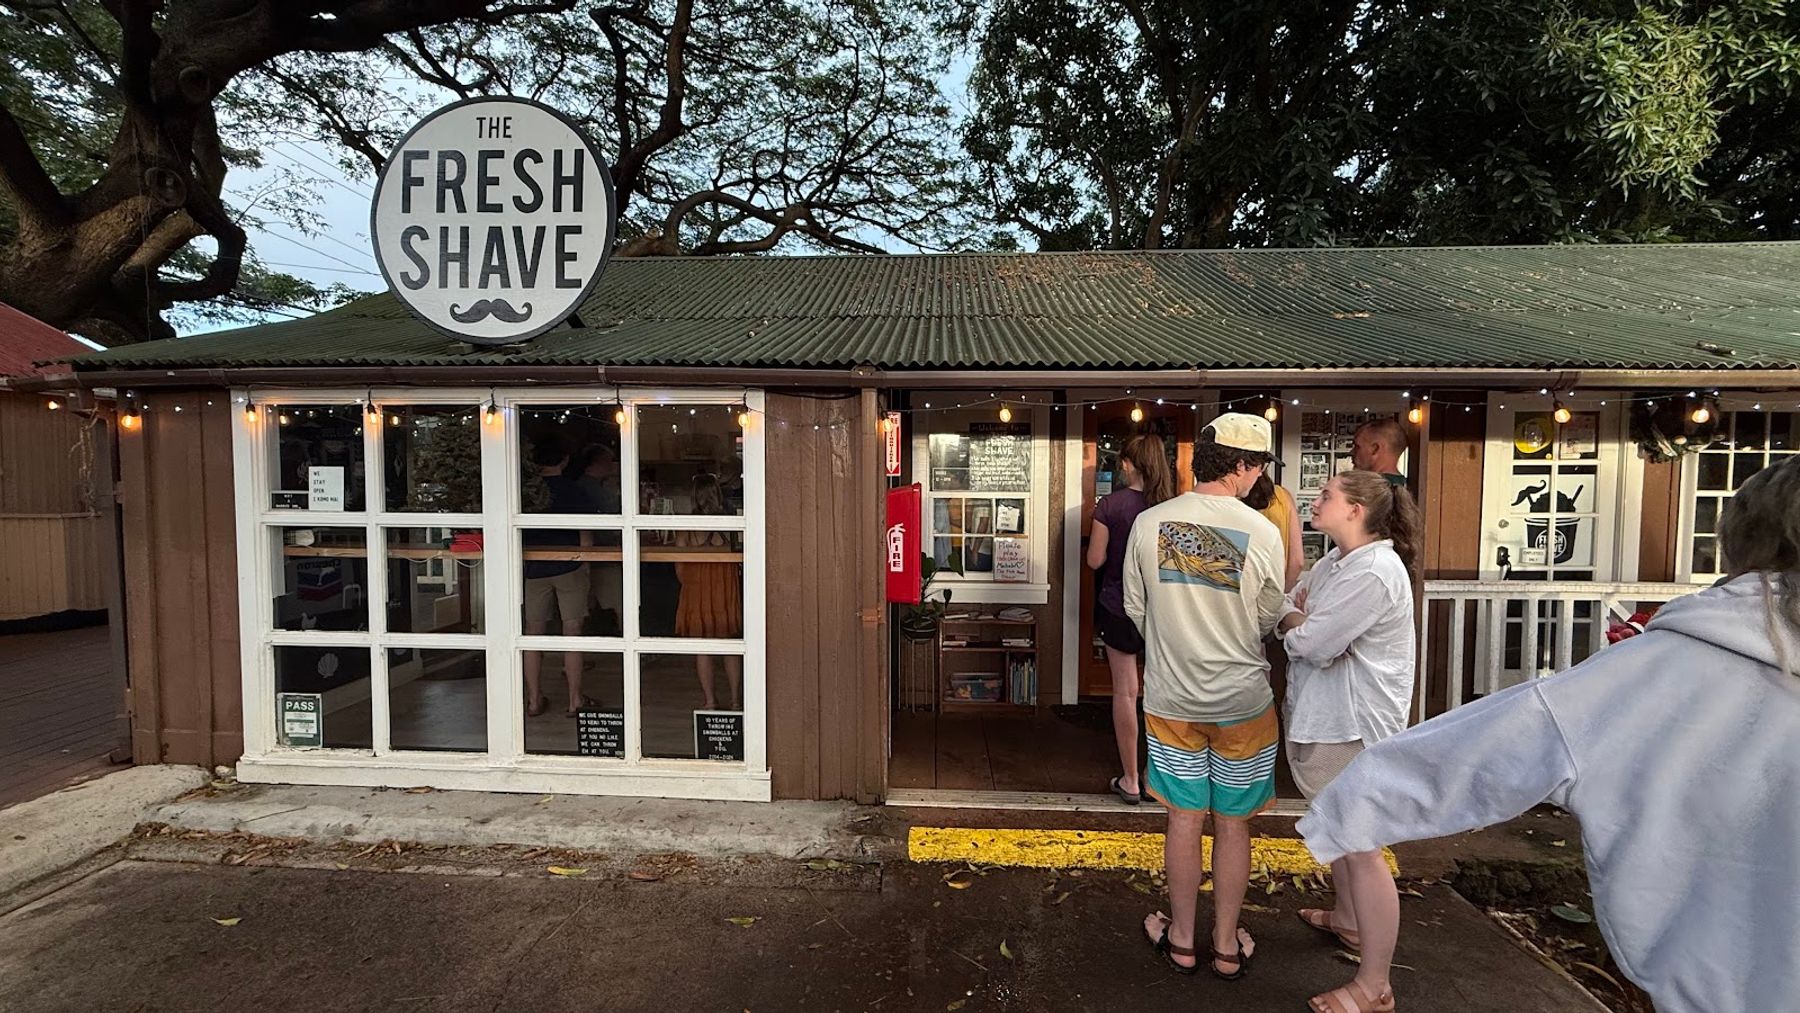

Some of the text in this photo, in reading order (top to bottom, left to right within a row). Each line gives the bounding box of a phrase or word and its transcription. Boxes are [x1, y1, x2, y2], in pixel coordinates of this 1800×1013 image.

[476, 117, 512, 138] THE
[401, 149, 585, 214] FRESH
[400, 225, 583, 290] SHAVE
[984, 446, 1014, 456] SHAVE
[893, 537, 901, 567] FIRE
[286, 701, 315, 710] PASS
